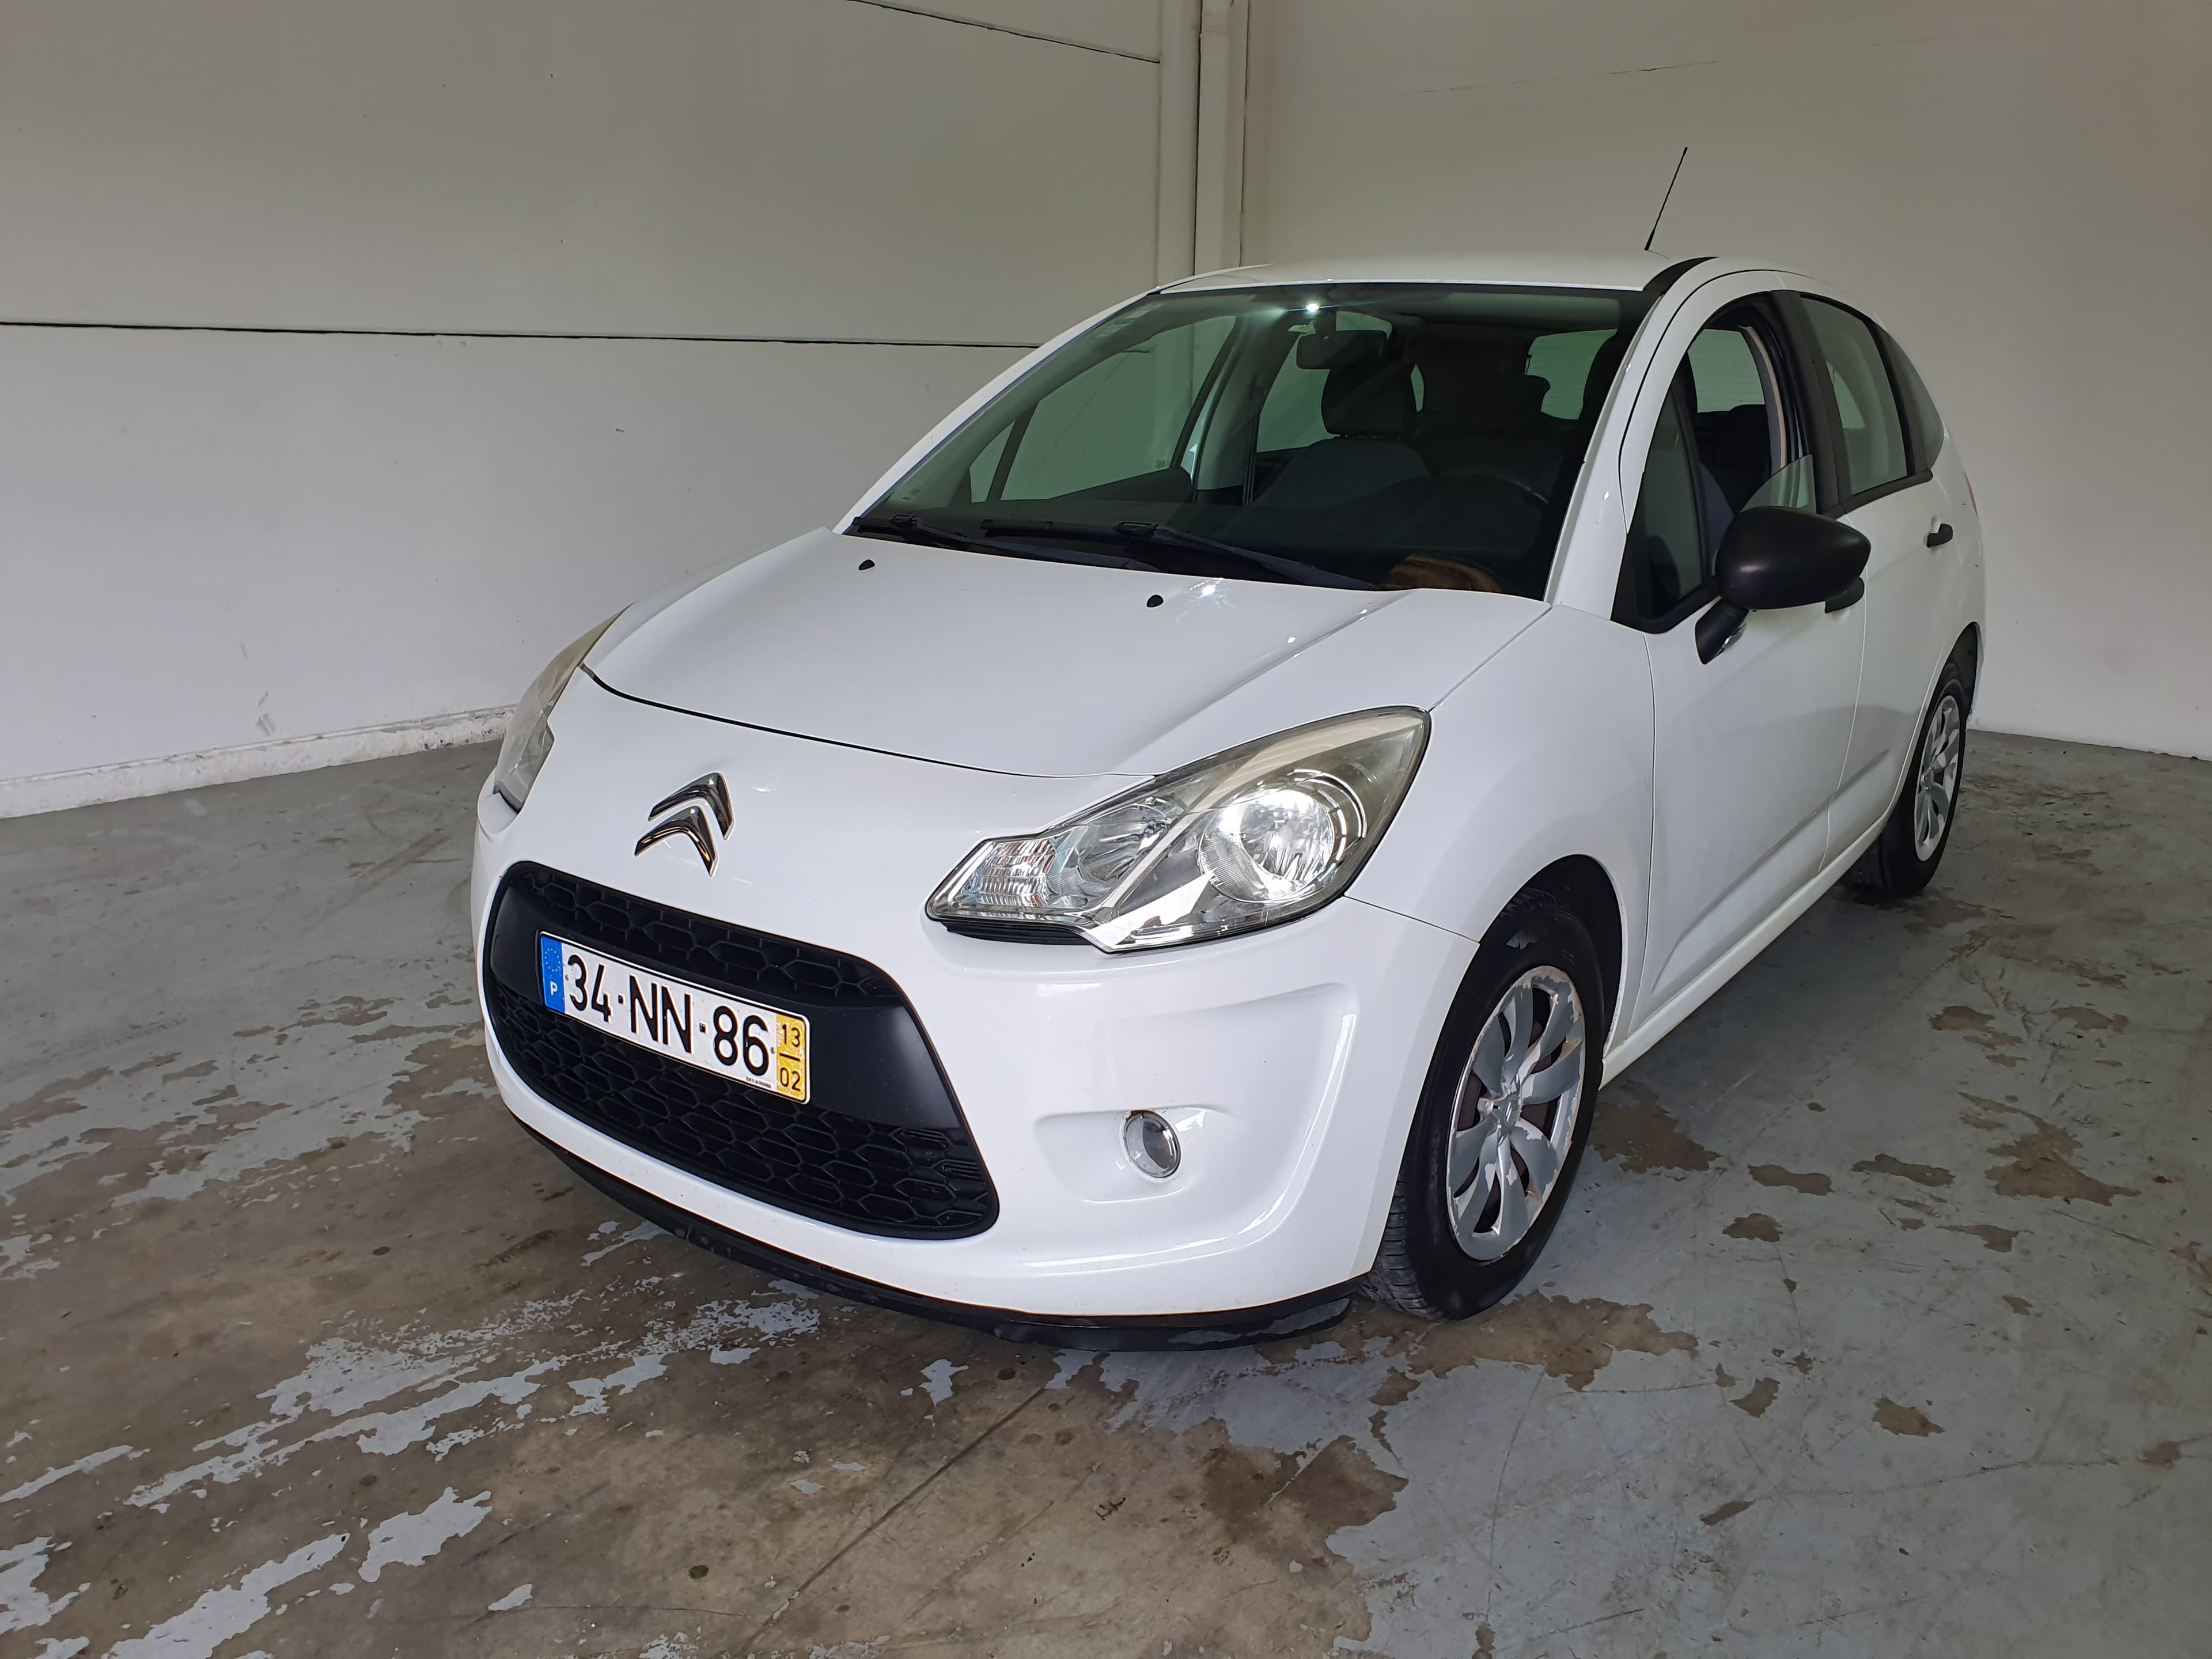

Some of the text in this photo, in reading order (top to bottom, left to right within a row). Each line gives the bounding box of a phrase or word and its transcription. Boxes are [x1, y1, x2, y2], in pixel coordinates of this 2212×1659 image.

[550, 980, 558, 996] P
[782, 1024, 801, 1048] 13
[780, 1067, 801, 1092] 02
